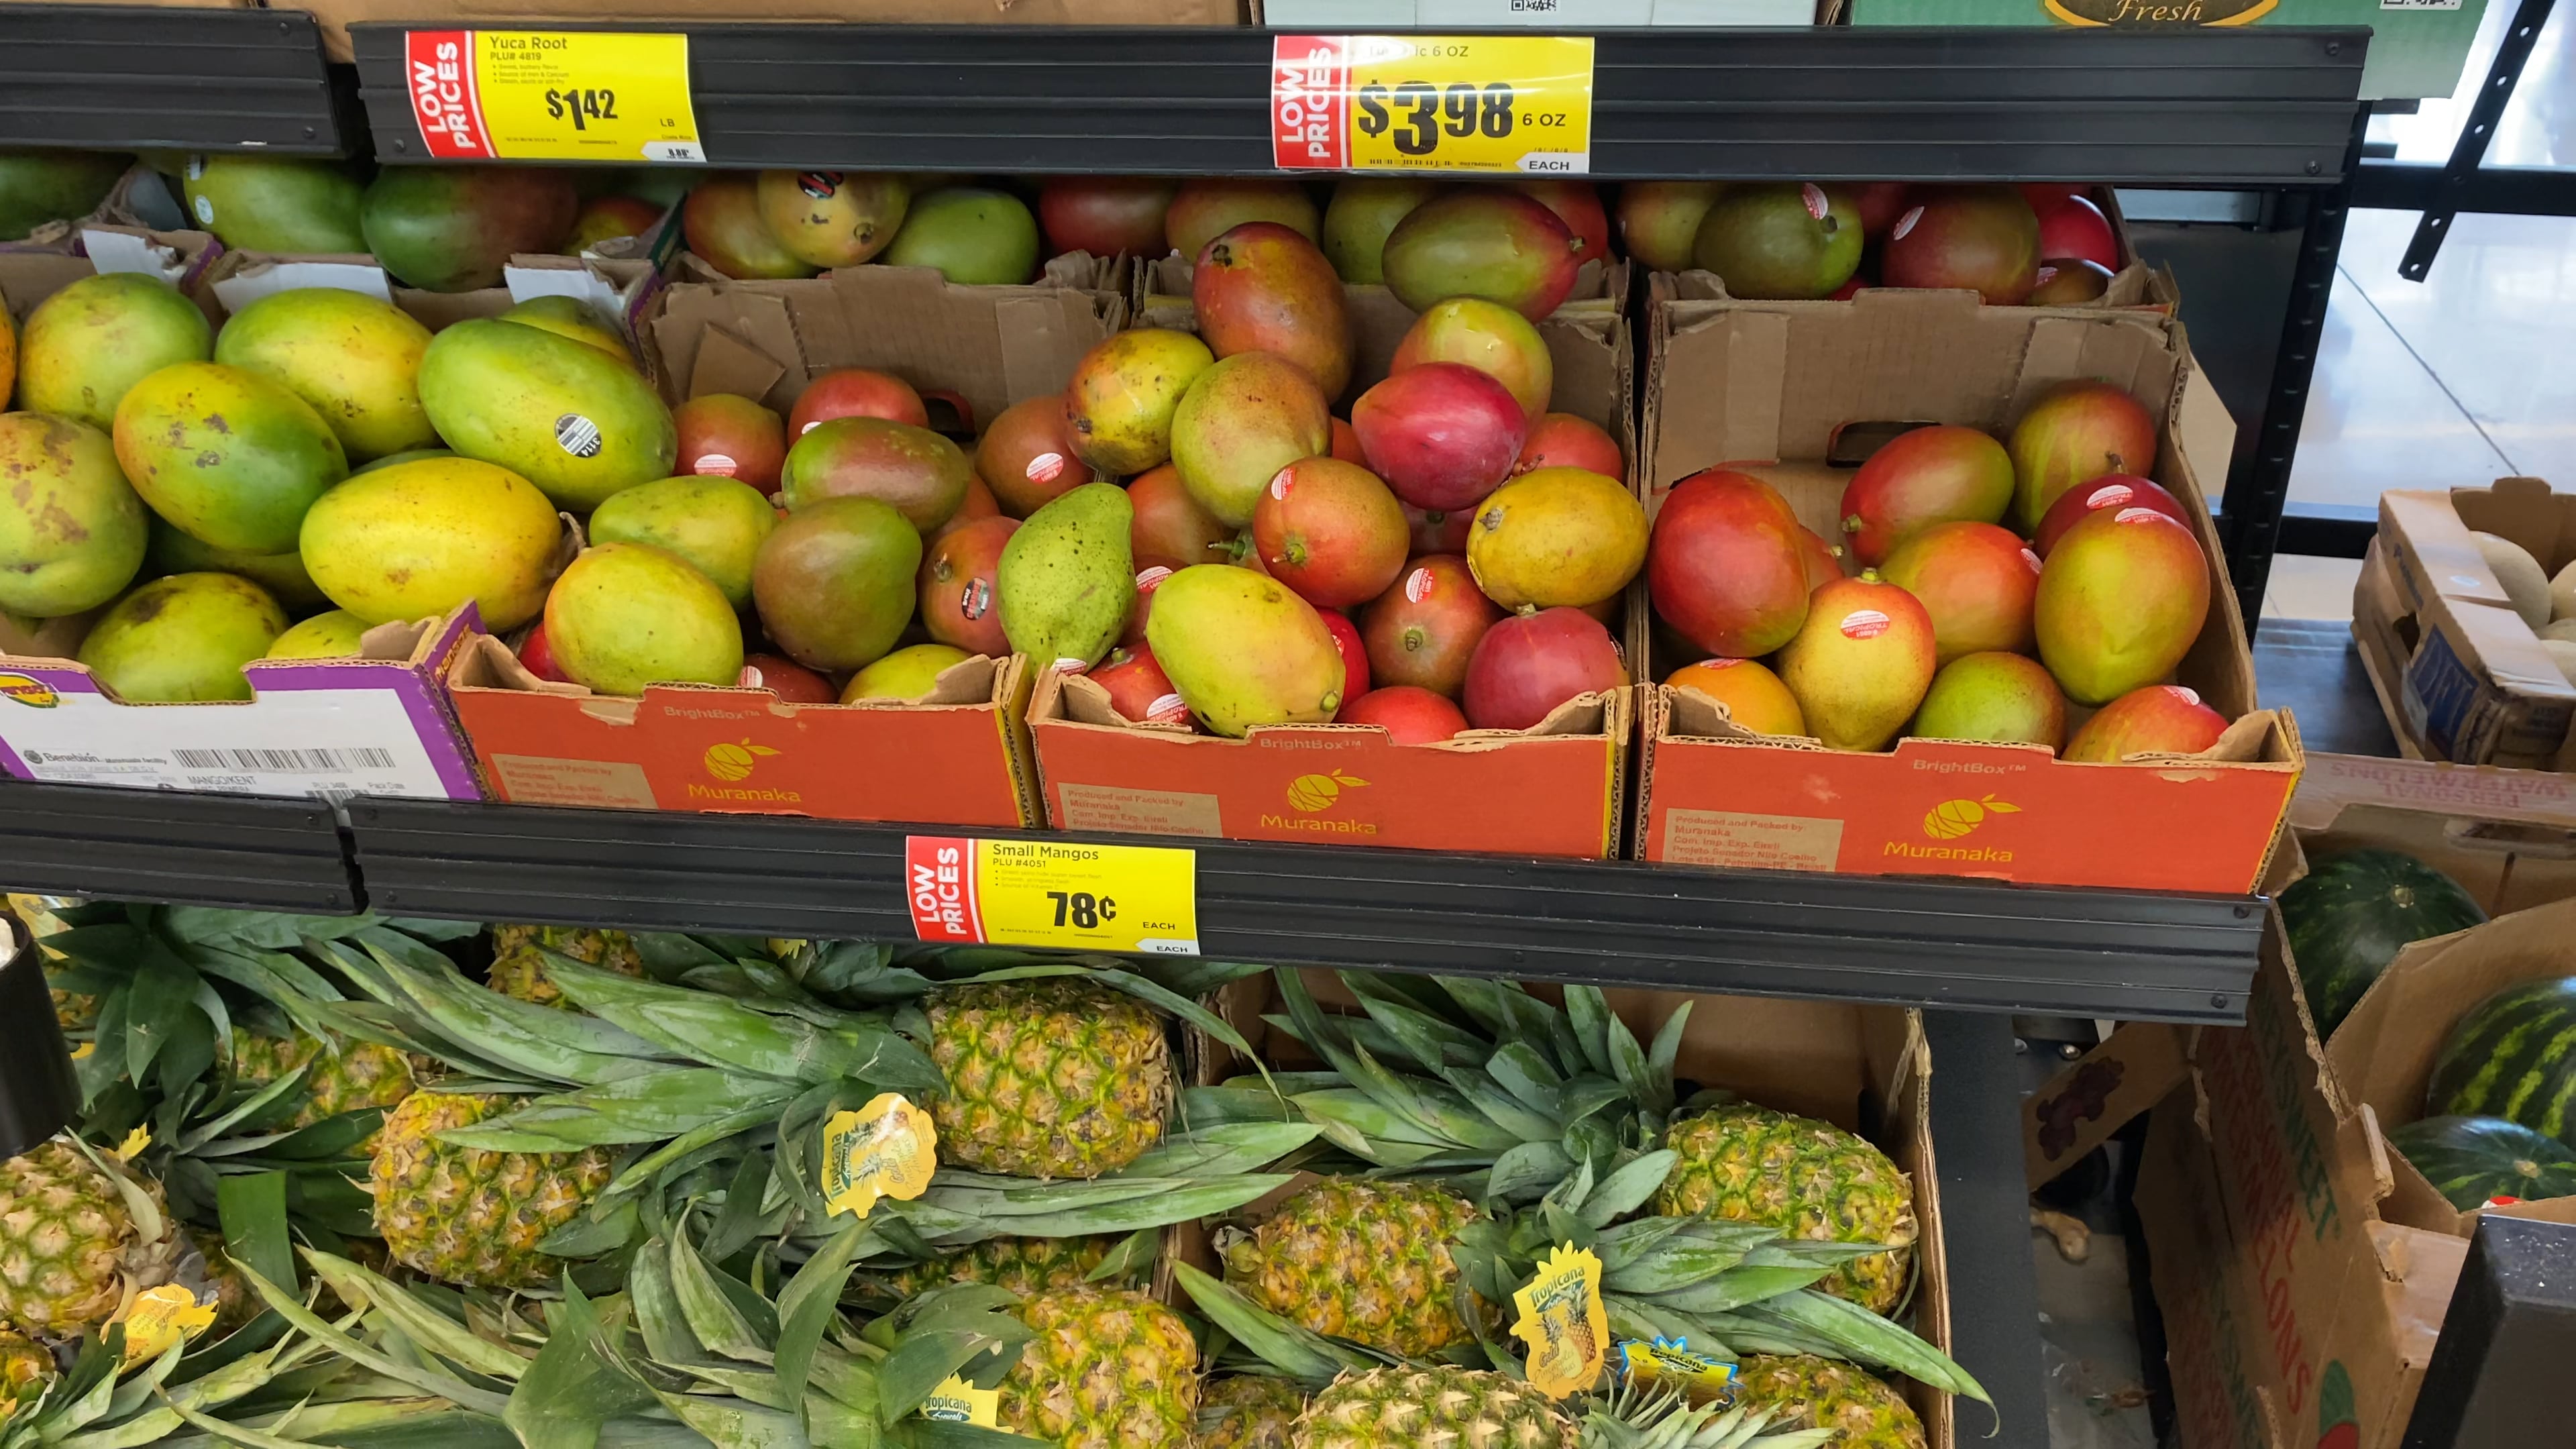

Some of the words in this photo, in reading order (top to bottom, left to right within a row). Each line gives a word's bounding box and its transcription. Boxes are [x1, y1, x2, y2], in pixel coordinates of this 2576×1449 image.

[2108, 0, 2203, 21] Fresh
[490, 36, 526, 49] Yuca
[532, 37, 568, 49] Root
[1432, 46, 1442, 56] 6
[1446, 46, 1469, 57] OZ
[414, 60, 449, 133] LOW
[436, 42, 477, 149] PRICES
[1280, 68, 1305, 143] LOW
[1306, 46, 1332, 158] PRICES
[659, 118, 676, 127] LB
[1522, 113, 1533, 126] 6
[1540, 113, 1566, 127] OZ
[1529, 160, 1570, 171] EACH
[1843, 623, 1888, 634] TROPICAL
[2330, 761, 2567, 801] WATERMELONS
[688, 784, 801, 802] Muranaka
[2380, 782, 2520, 808] PERSONAL
[1260, 814, 1377, 835] Muranaka
[1675, 815, 1726, 826] Produced
[1728, 819, 1748, 827] and
[1750, 820, 1789, 830] Packed
[1675, 825, 1731, 837] Muranaka
[993, 844, 1034, 857] Small
[1040, 846, 1099, 861] Mangos
[1883, 841, 2013, 863] Muranaka
[993, 858, 1012, 866] PLU
[1016, 859, 1046, 868] #4051
[914, 863, 941, 923] LOW
[937, 847, 967, 935] PRICES
[1046, 891, 1117, 929] 78¢
[1143, 921, 1175, 930] EACH
[1157, 945, 1188, 953] EACH
[830, 1132, 845, 1200] Tropicana
[1527, 1266, 1585, 1308] Tropicana
[1649, 1348, 1708, 1372] Tropicana
